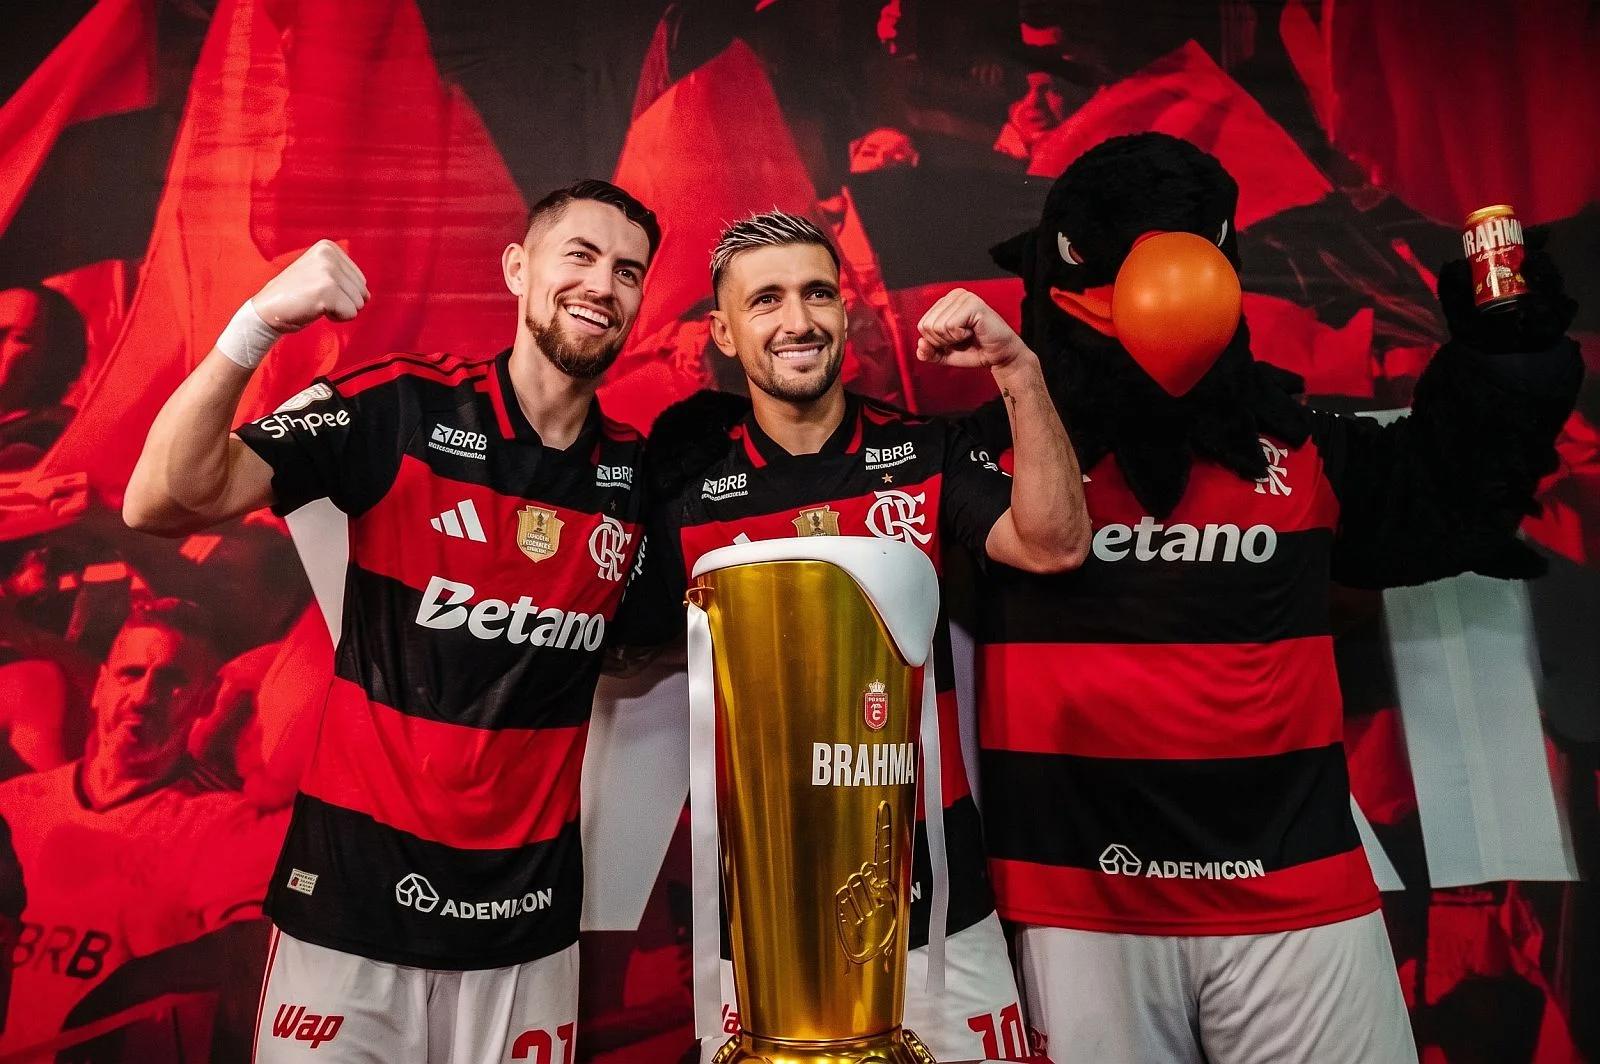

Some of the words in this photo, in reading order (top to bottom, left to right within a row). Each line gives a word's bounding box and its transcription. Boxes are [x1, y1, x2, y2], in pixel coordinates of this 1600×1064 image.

[260, 409, 350, 438] Shpee
[450, 429, 488, 451] BRB
[880, 441, 914, 461] BRB
[717, 473, 747, 494] BRB
[1092, 516, 1278, 563] etano
[415, 576, 604, 652] Betano
[811, 742, 915, 787] BRAHMA
[1145, 858, 1266, 880] ADEMICON
[11, 923, 112, 979] BRB
[272, 1003, 344, 1049] Wap
